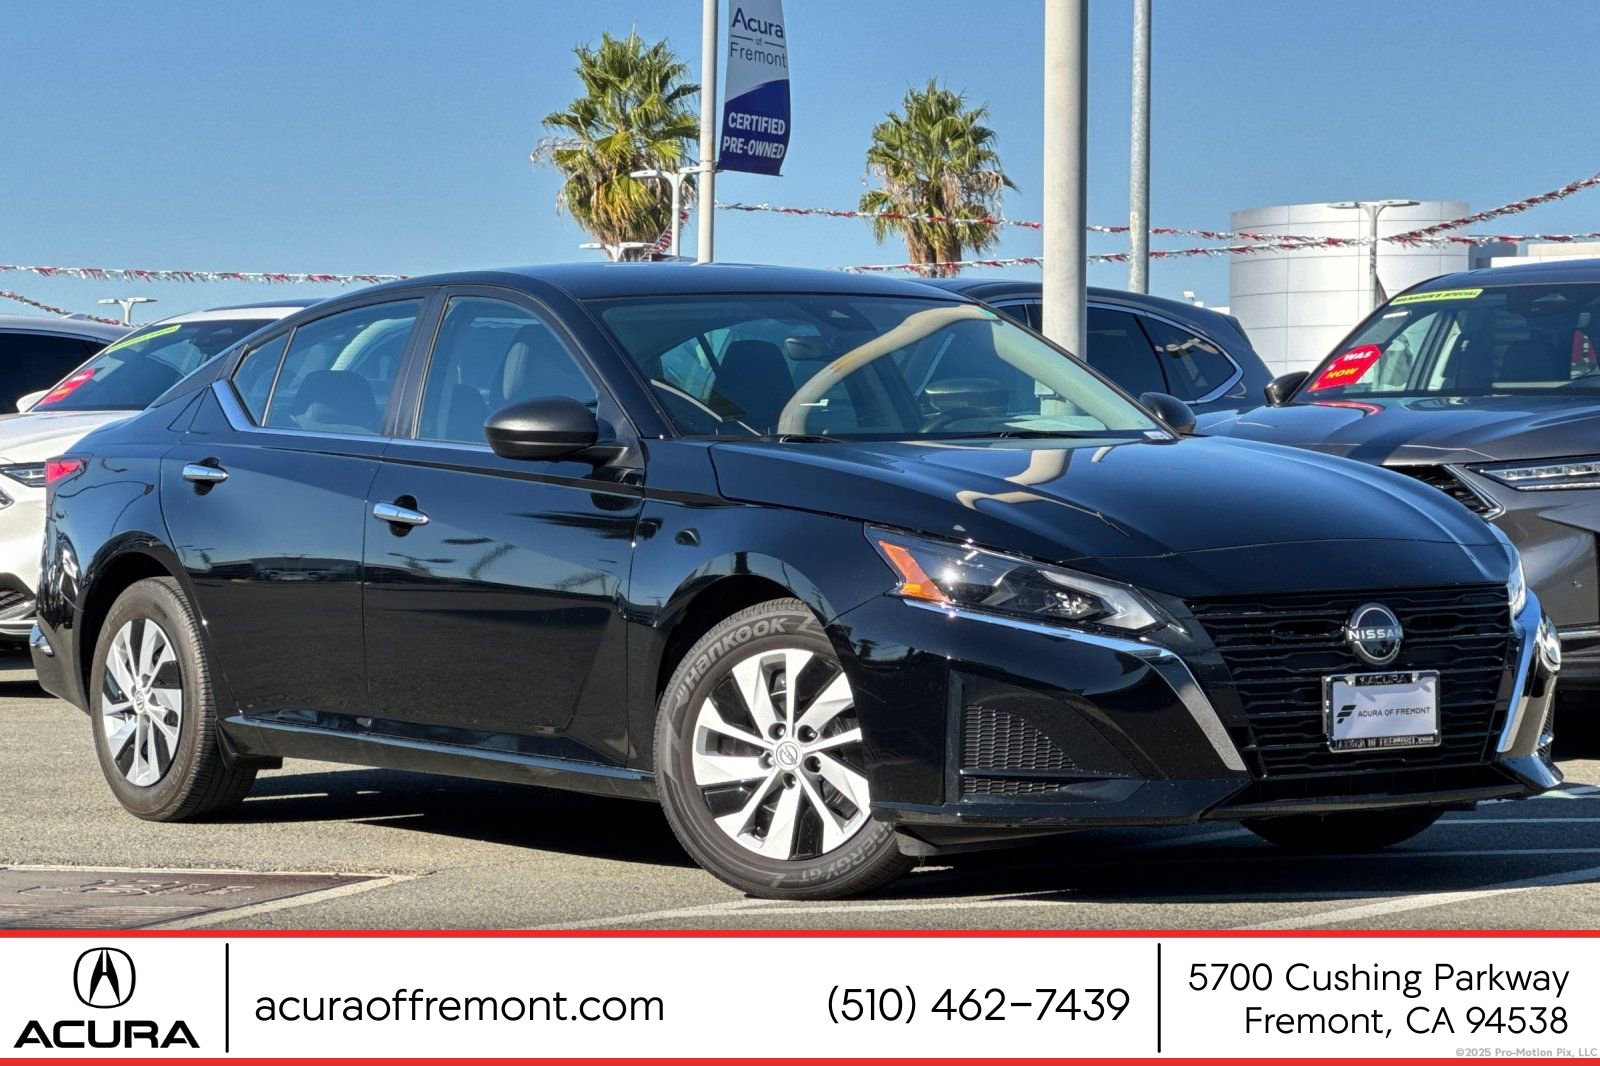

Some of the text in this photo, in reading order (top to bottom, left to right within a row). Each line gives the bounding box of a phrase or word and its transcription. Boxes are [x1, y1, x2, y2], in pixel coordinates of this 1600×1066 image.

[732, 8, 784, 38] Acura
[755, 38, 763, 46] of
[730, 42, 787, 68] Fremont
[728, 112, 786, 136] CERTIFIED
[722, 136, 785, 159] PRE-OWNED
[1343, 351, 1374, 361] WAS
[1326, 368, 1359, 379] NOW
[1349, 629, 1403, 640] NISSAN
[1367, 674, 1408, 685] ACURA
[1384, 708, 1394, 716] OF
[1395, 706, 1431, 715] FREMONT
